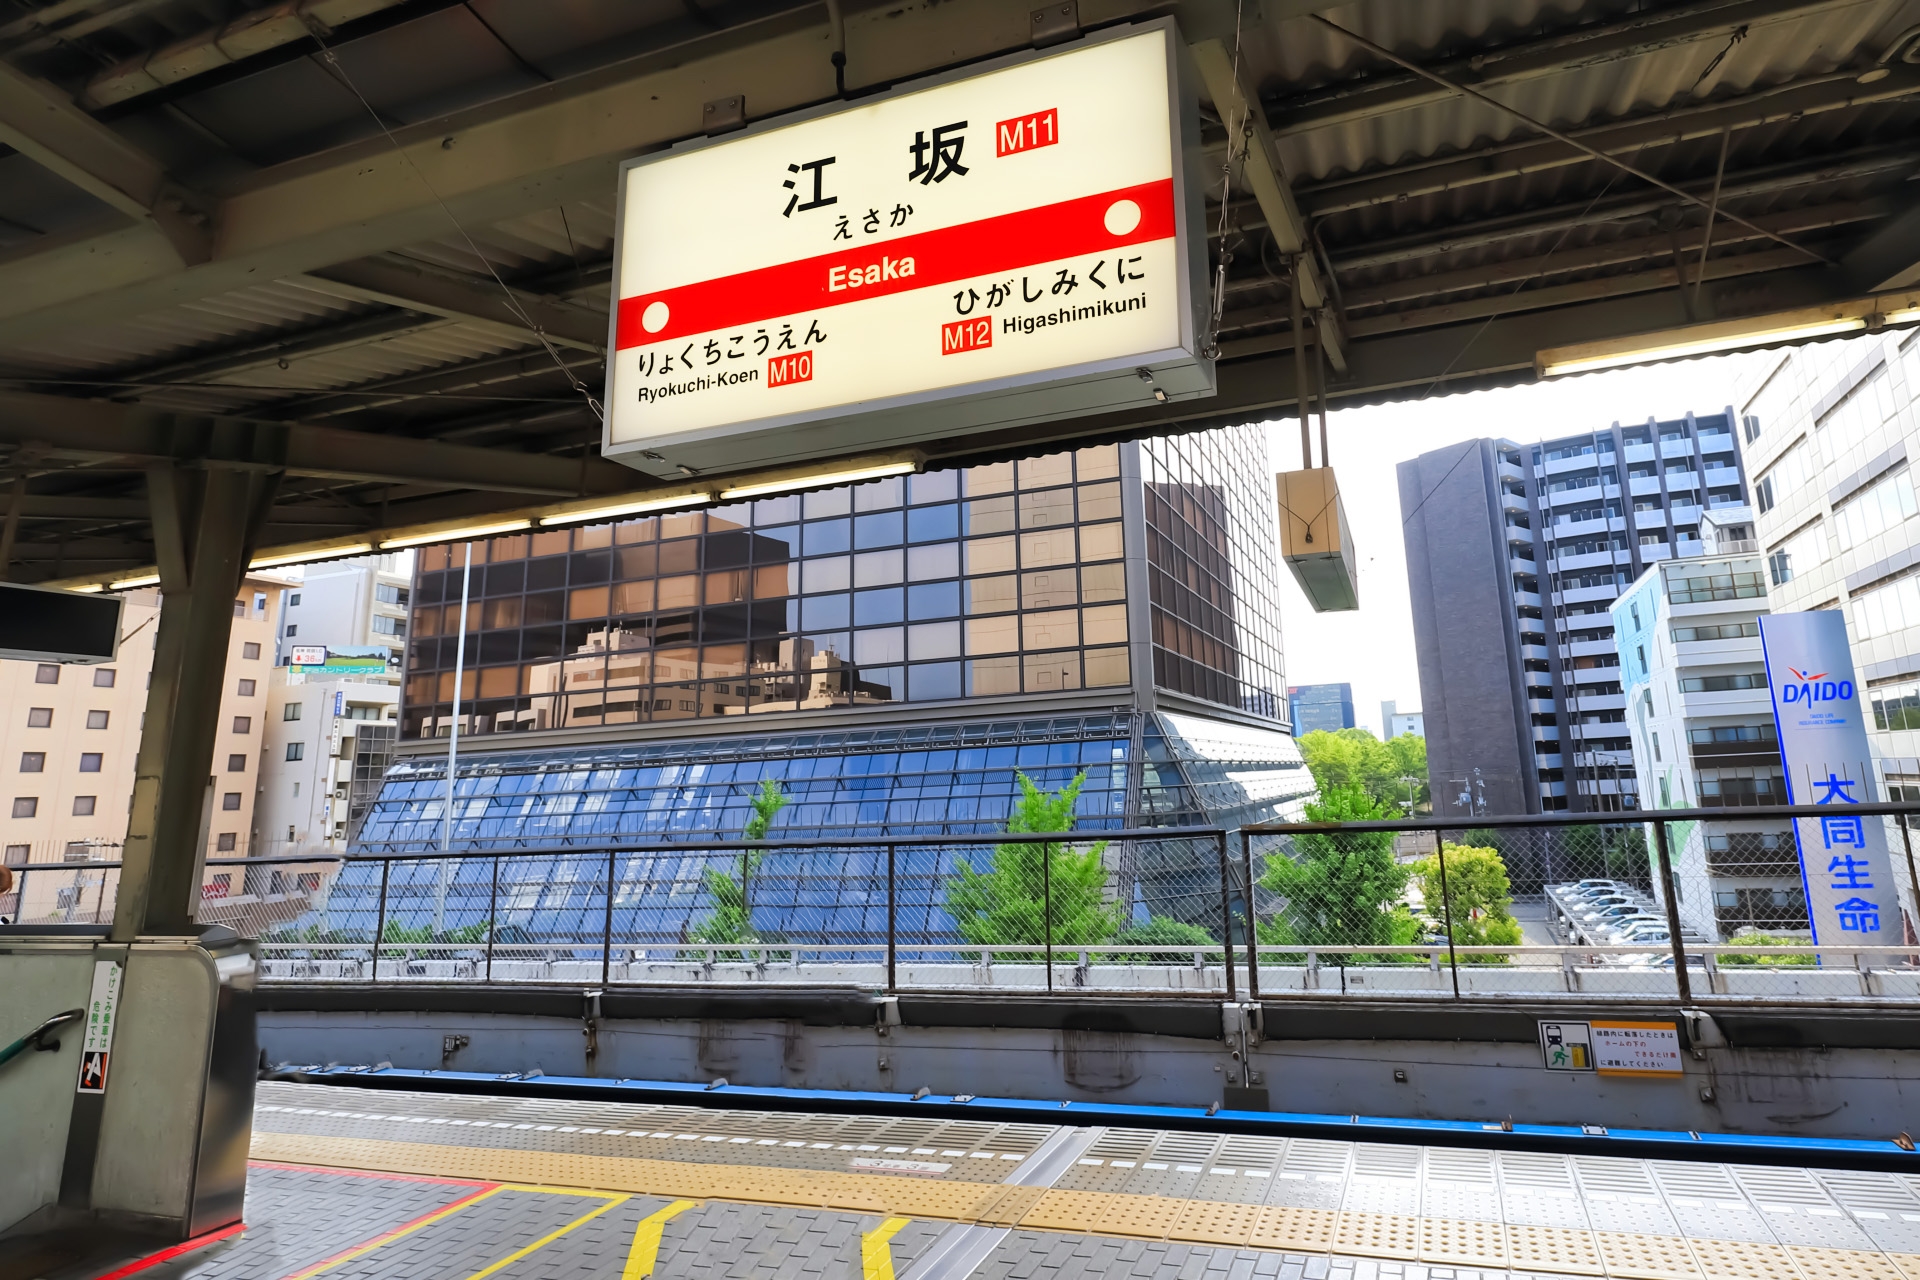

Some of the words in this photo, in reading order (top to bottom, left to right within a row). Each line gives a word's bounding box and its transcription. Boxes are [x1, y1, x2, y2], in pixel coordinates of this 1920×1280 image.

[1000, 113, 1056, 153] M11
[833, 203, 914, 241] えさか
[828, 254, 916, 293] Esaka
[953, 256, 1145, 315] ひがしみくに
[1002, 293, 1147, 336] Higashimikuni
[638, 320, 828, 378] りょくちこうえん
[945, 321, 990, 351] M12
[638, 367, 759, 402] Ryokuchi-Koen
[770, 356, 812, 384] M10
[1783, 681, 1853, 709] DAIDO
[1813, 774, 1880, 934] 大同生命
[88, 1001, 101, 1048] 危険です
[100, 965, 118, 1048] かけこみ乗車は
[1605, 1040, 1647, 1048] ホームの下の
